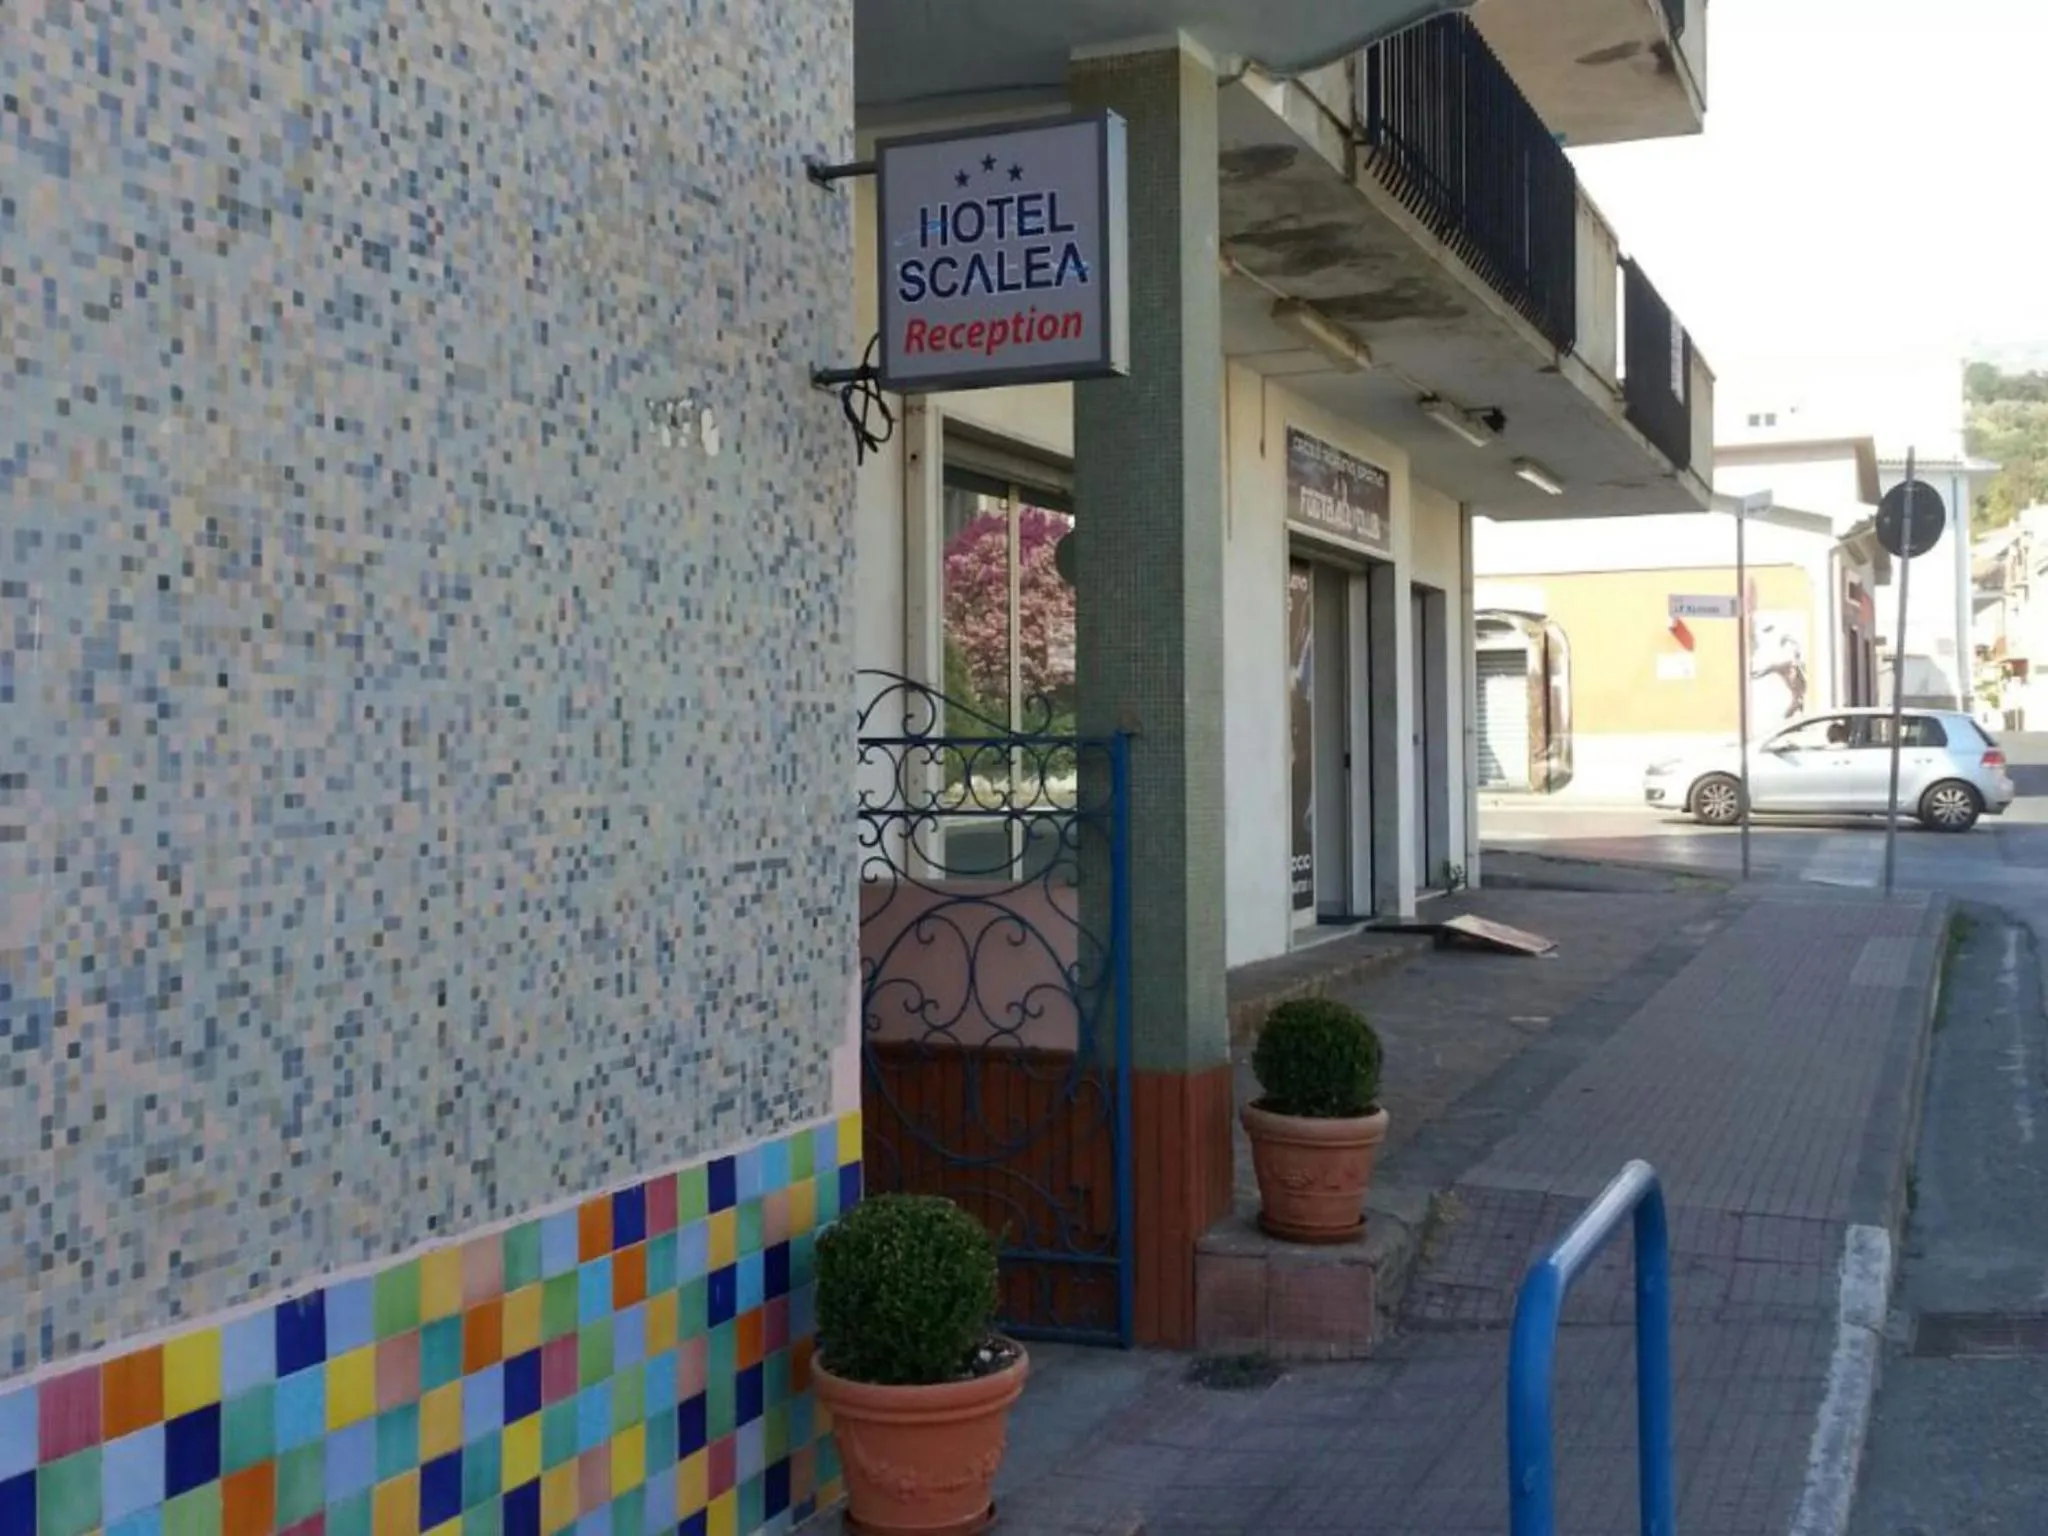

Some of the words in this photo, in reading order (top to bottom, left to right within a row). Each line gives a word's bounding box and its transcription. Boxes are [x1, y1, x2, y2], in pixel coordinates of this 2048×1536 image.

[919, 192, 1074, 248] HOTEL
[899, 242, 1088, 302] SCALEA
[904, 305, 1083, 356] Reception
